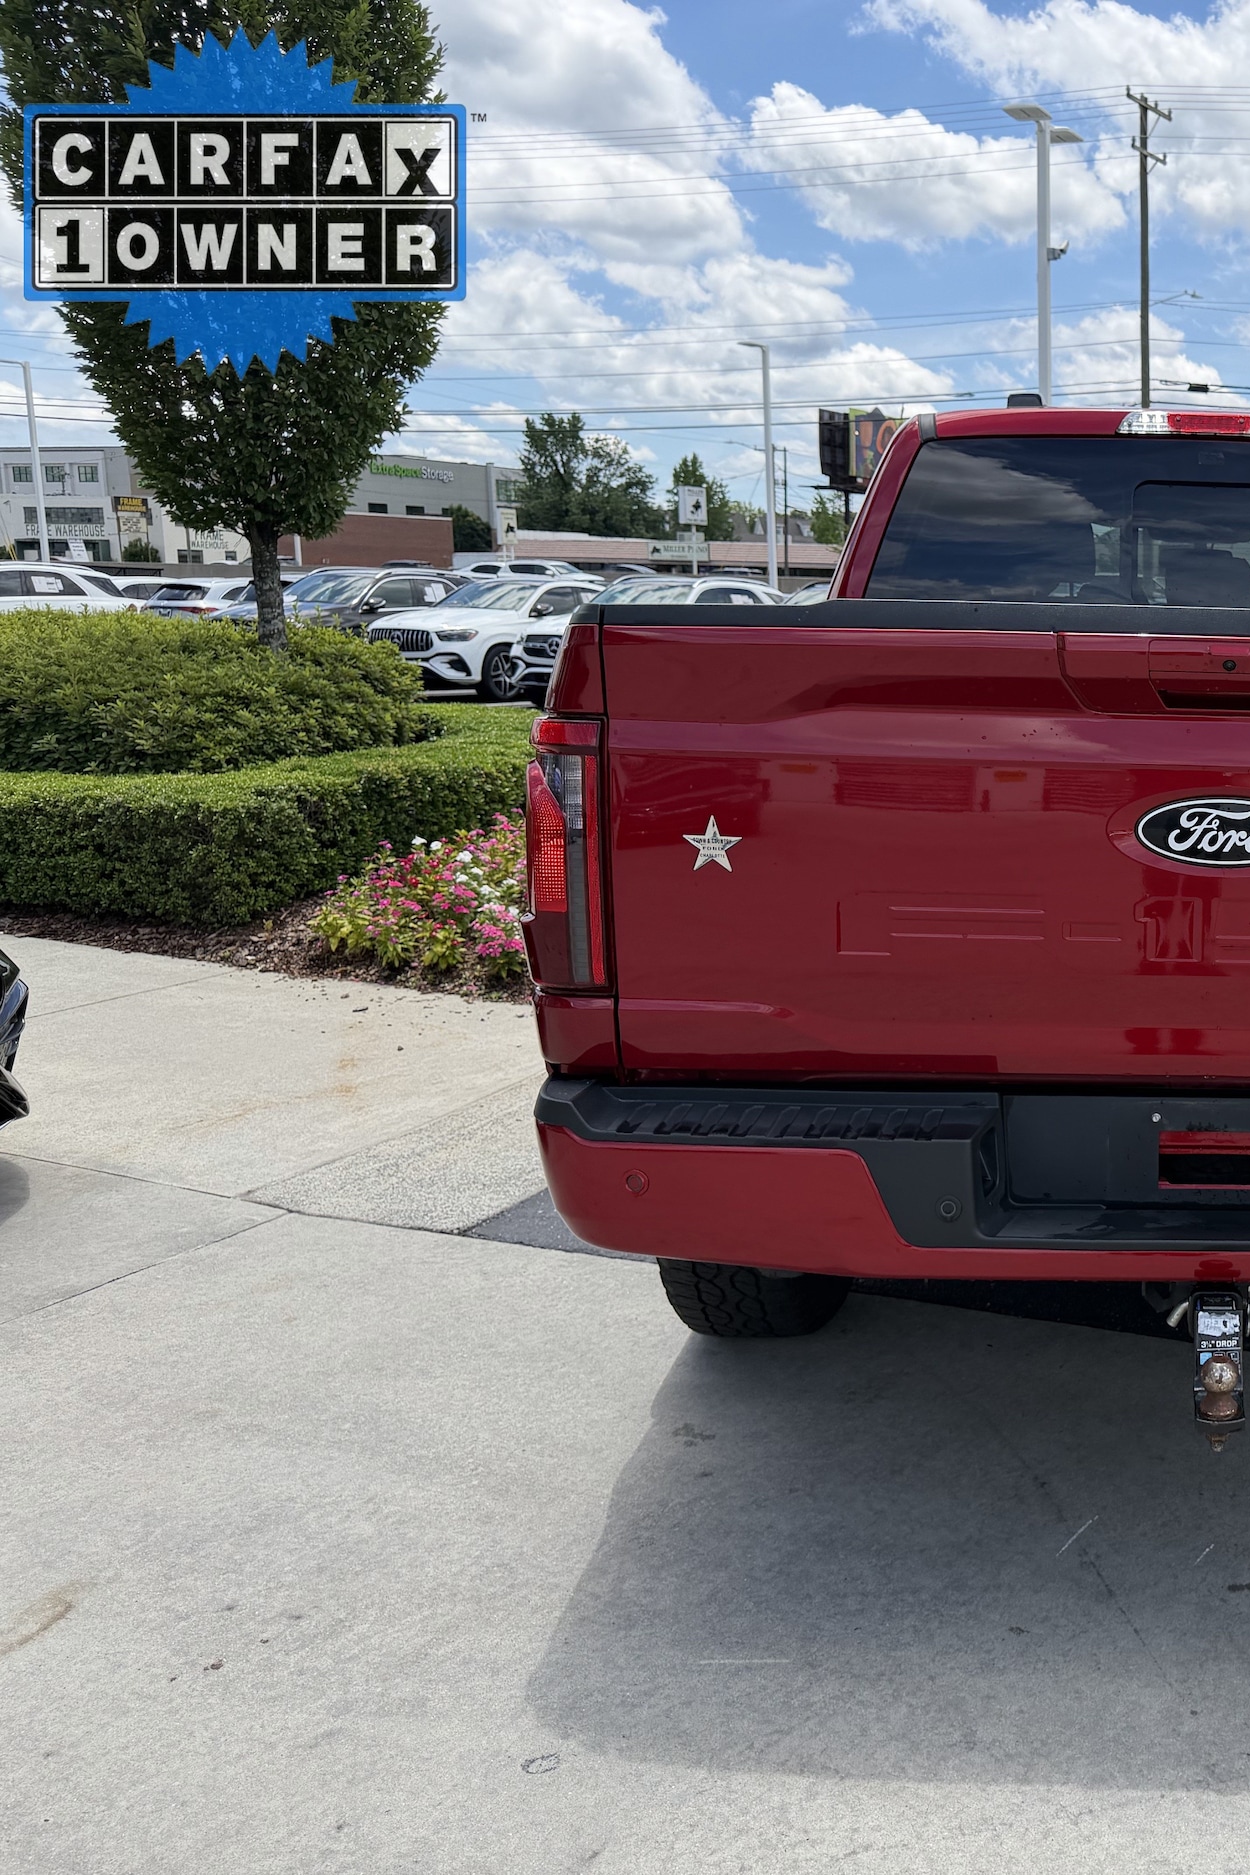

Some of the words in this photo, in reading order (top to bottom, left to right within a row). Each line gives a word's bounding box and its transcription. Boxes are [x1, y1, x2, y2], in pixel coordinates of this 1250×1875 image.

[120, 498, 143, 506] FRAME
[55, 524, 105, 537] WAREHOUSE
[191, 541, 229, 550] WAREHOUSE
[1216, 1340, 1237, 1348] DROP
